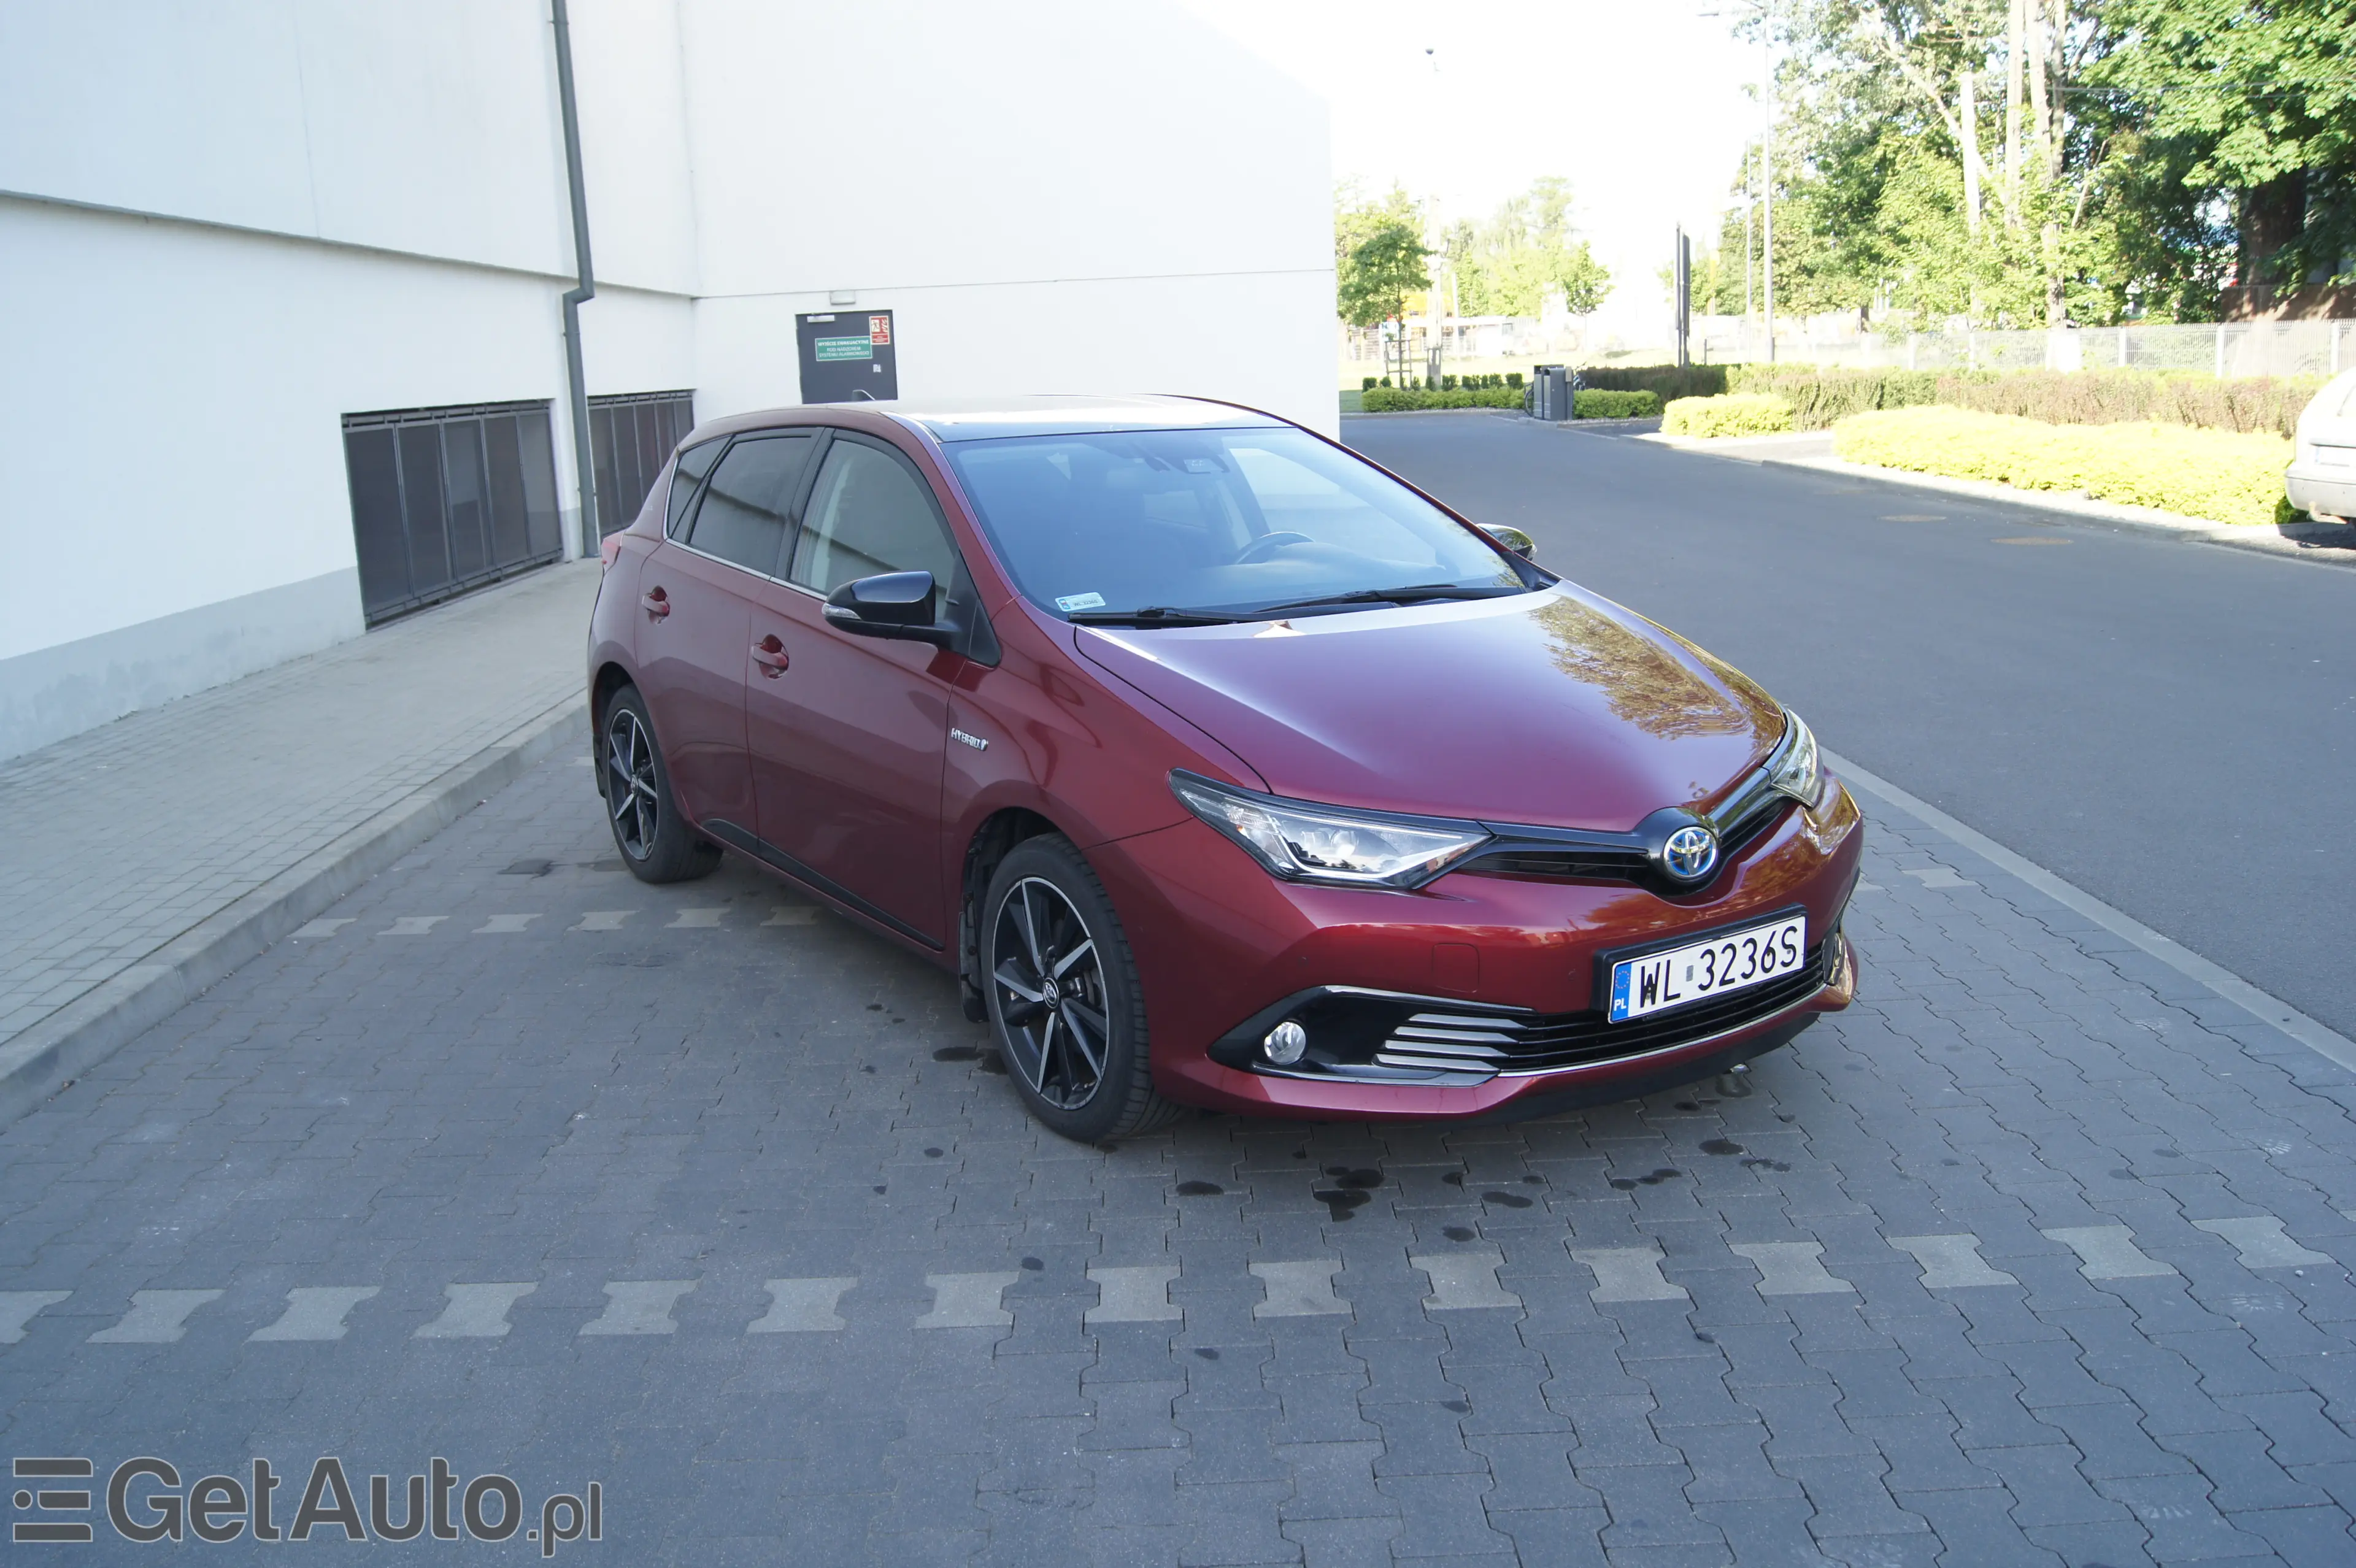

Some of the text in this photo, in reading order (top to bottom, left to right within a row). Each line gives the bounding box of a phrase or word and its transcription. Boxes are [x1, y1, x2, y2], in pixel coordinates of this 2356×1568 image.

[951, 728, 980, 748] HYBRID
[1639, 926, 1798, 1008] WL 3236S
[1614, 998, 1627, 1012] PL
